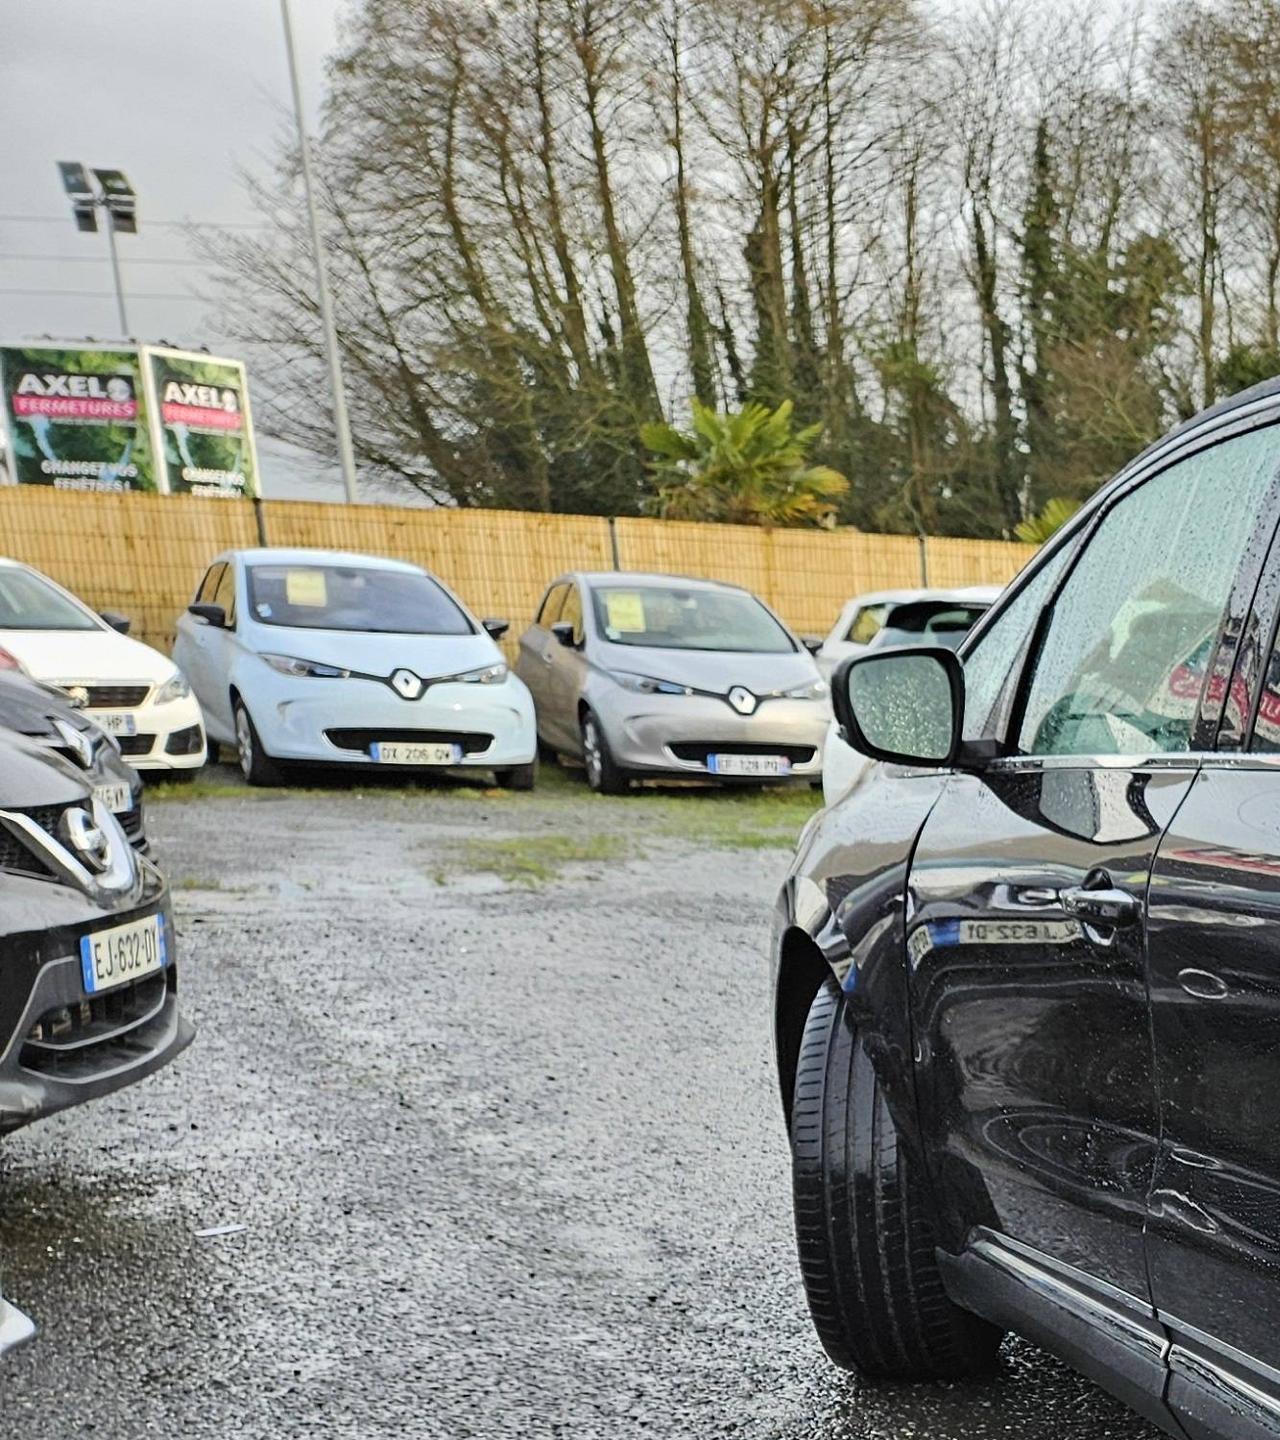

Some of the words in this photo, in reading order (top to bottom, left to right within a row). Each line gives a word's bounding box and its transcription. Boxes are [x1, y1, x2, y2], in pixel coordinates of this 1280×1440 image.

[17, 373, 108, 398] AXEL
[164, 381, 224, 409] AXEL
[19, 397, 135, 416] FERMETURES
